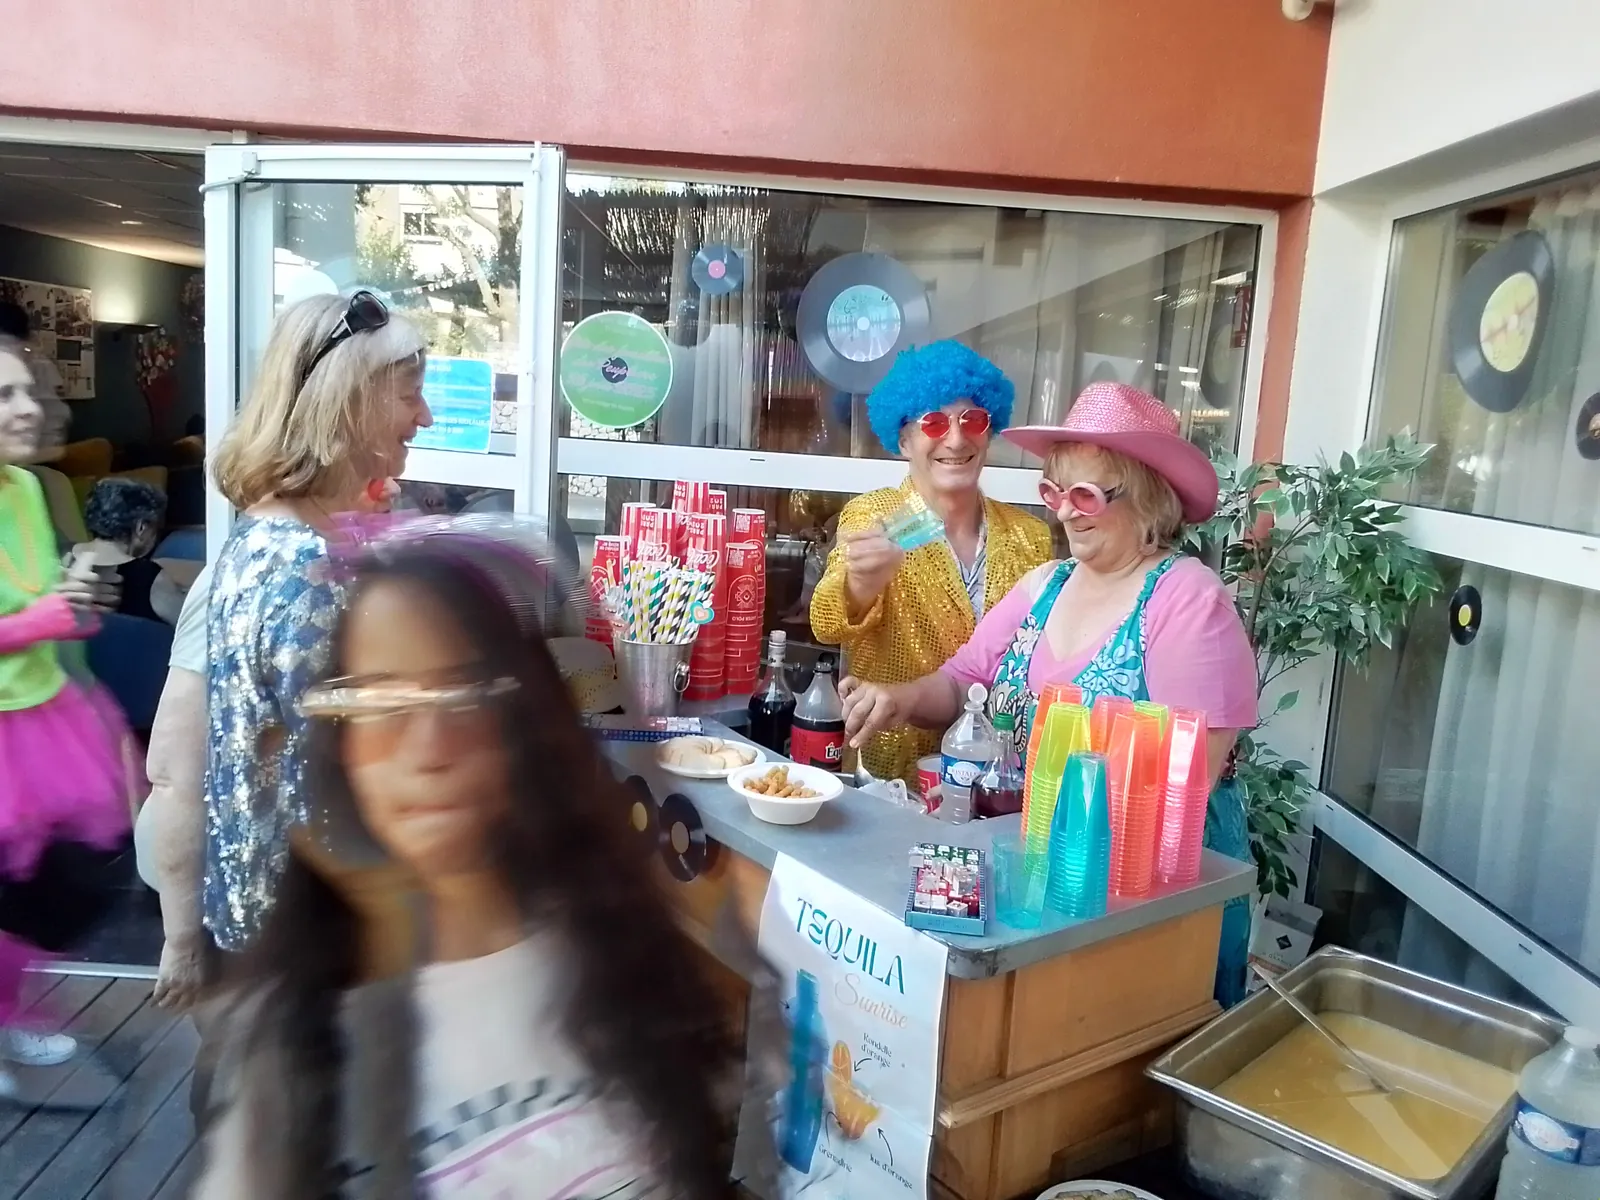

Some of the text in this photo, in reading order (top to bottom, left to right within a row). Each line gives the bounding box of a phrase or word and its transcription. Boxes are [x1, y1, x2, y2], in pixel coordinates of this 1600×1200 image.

[797, 897, 905, 995] TEQUILA
[834, 972, 909, 1029] Sunrise
[863, 1032, 892, 1058] Rondelle
